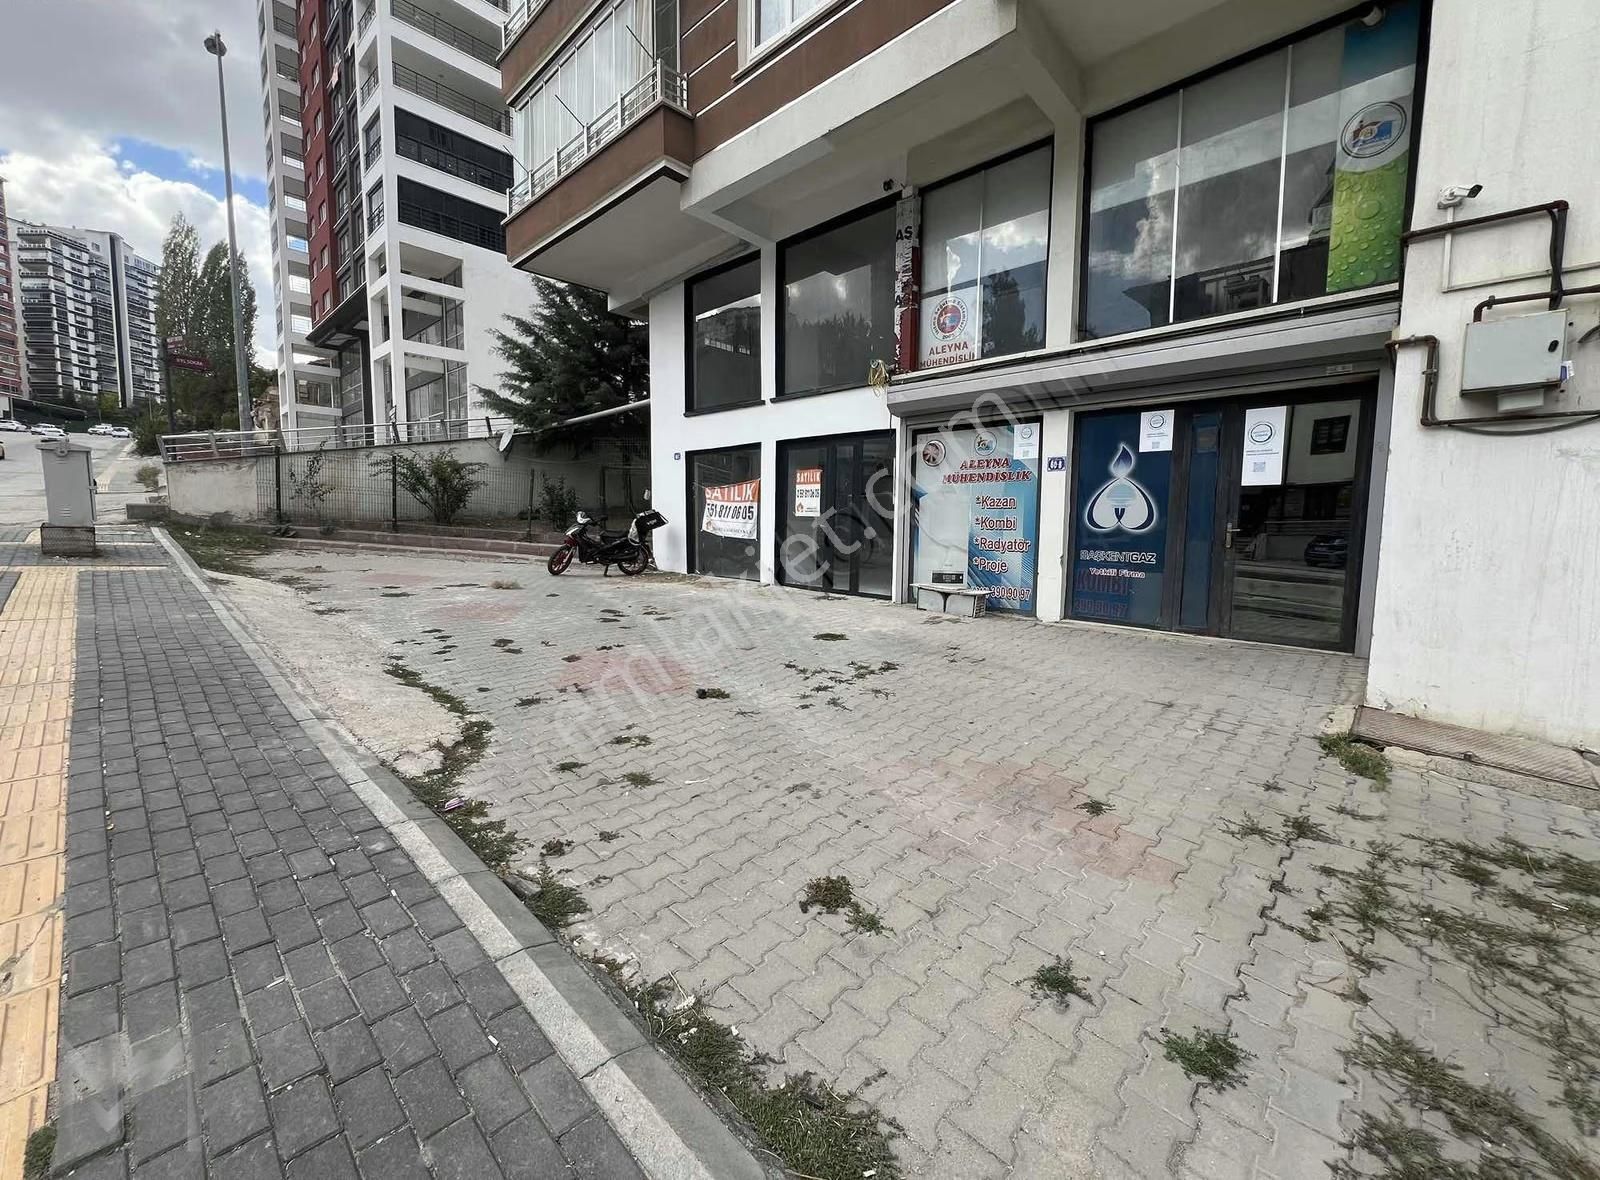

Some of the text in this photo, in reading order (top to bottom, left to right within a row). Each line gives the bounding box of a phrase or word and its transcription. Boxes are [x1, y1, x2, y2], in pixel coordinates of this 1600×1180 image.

[929, 341, 968, 356] ALEYNA
[960, 457, 1011, 471] ALEYNA
[796, 470, 821, 483] SATILIK
[943, 469, 1033, 484] MÜHENDİSLİK
[705, 482, 756, 501] SATILIK
[741, 505, 754, 520] 05
[1089, 567, 1146, 579] Yetkili Firma
[991, 586, 1006, 598] 390
[1006, 587, 1018, 600] 90
[1019, 588, 1031, 601] 97
